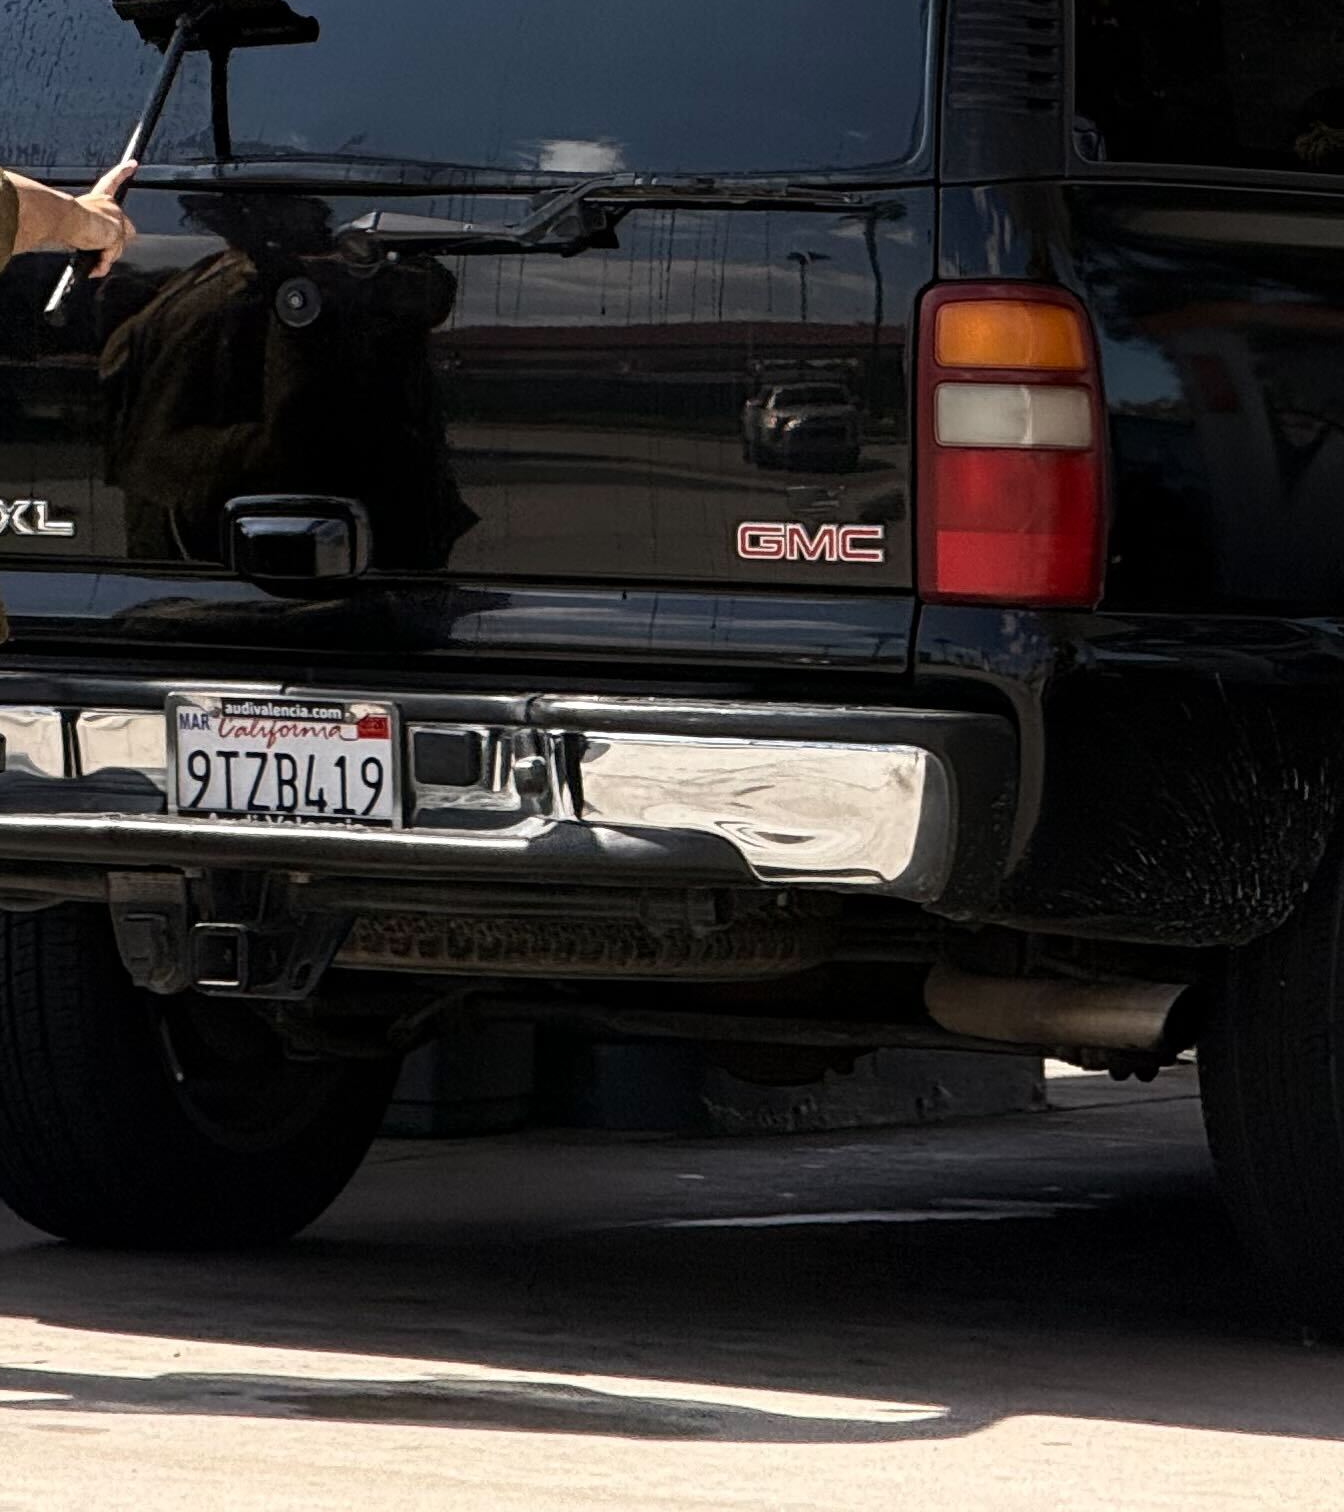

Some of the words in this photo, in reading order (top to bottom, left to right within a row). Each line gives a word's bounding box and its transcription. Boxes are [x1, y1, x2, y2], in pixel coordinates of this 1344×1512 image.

[737, 521, 884, 563] GMC
[179, 712, 211, 731] MAR
[217, 716, 352, 749] California
[224, 702, 342, 720] audivalencia.com
[187, 749, 384, 816] 9TZB419
